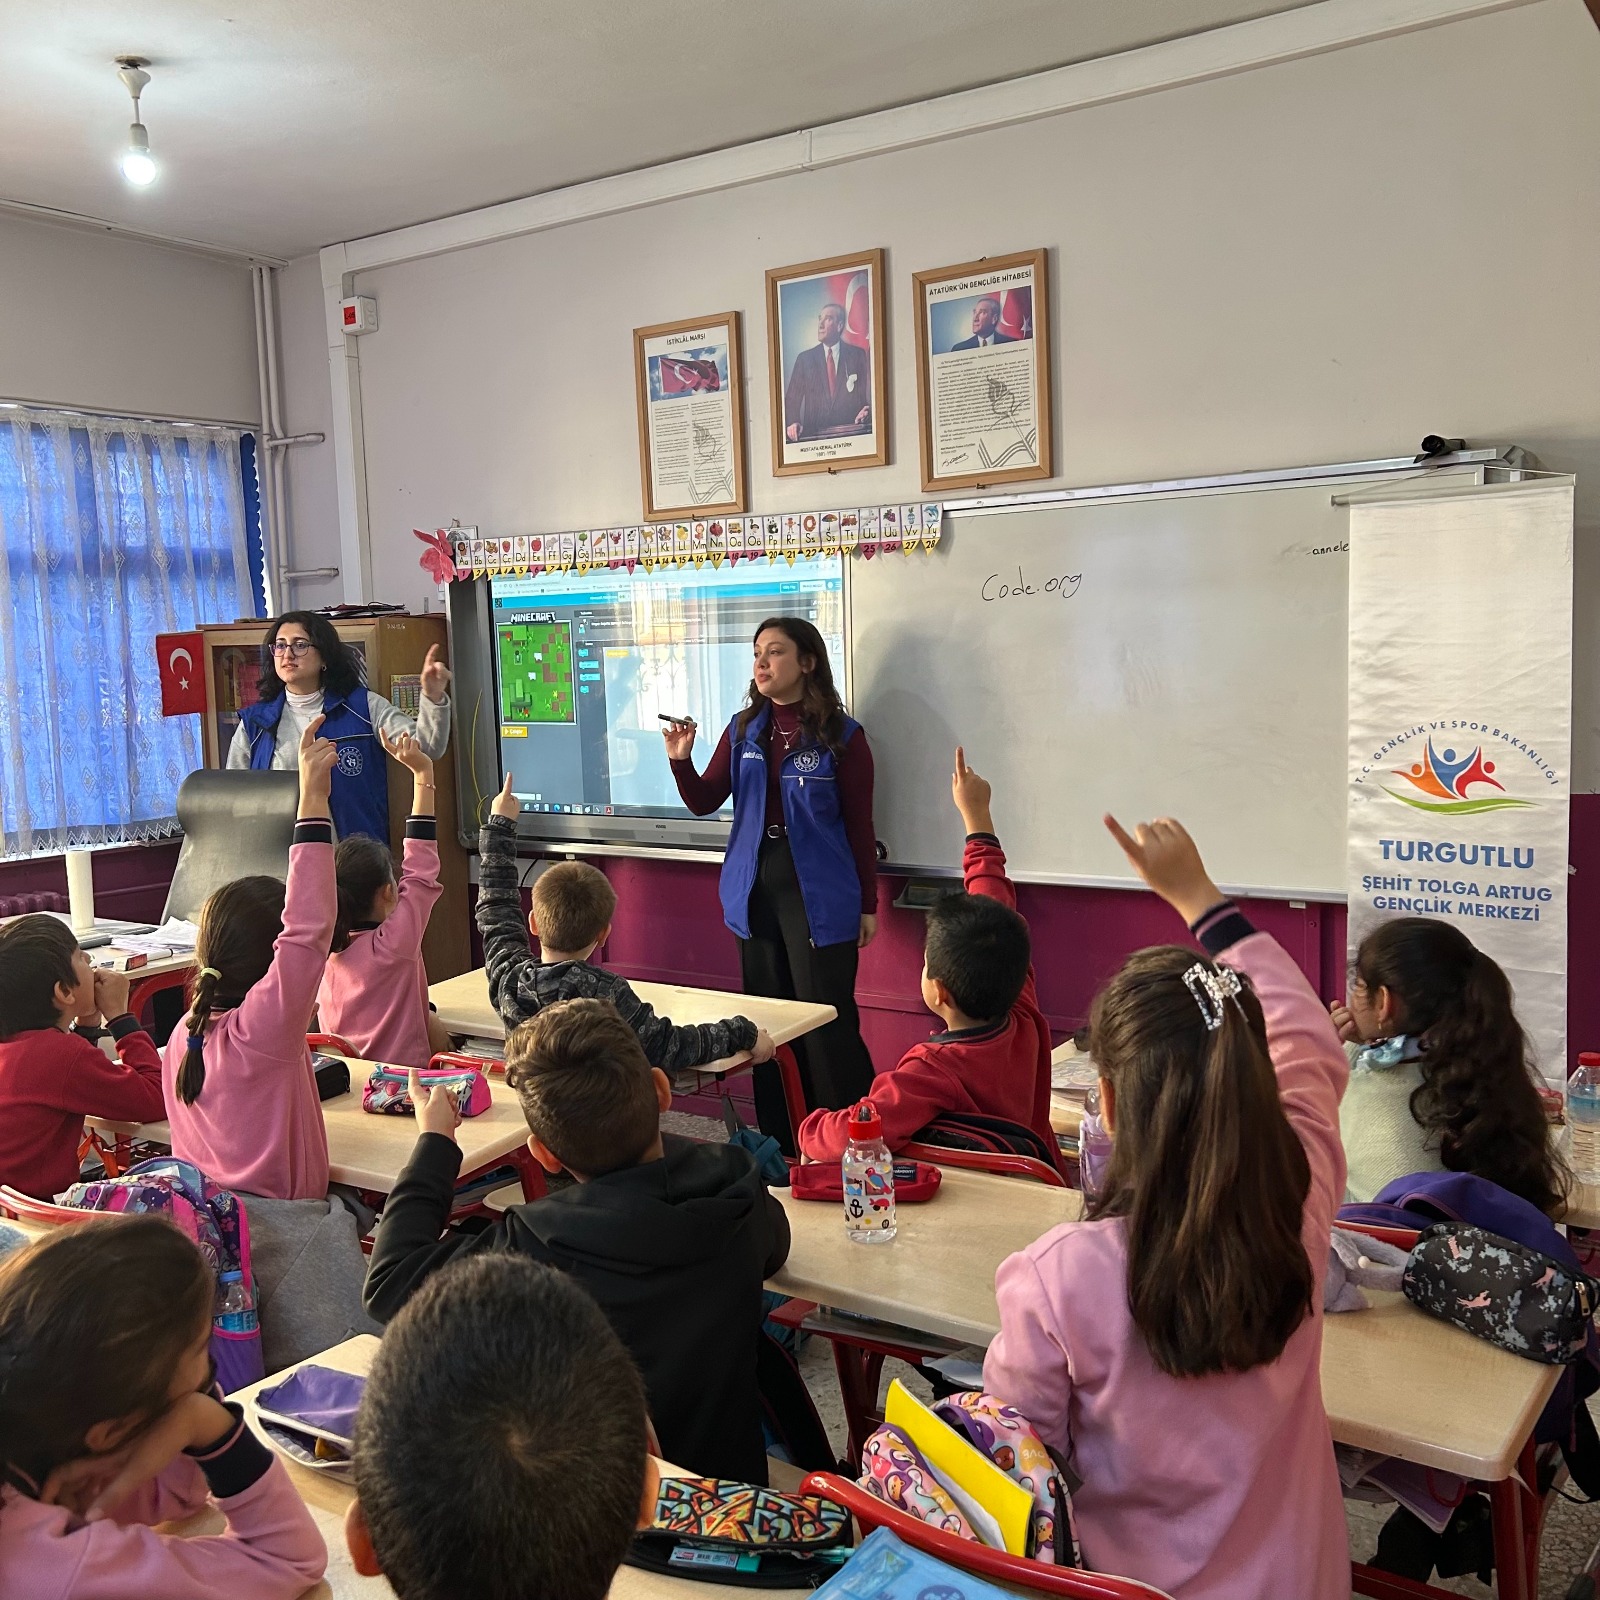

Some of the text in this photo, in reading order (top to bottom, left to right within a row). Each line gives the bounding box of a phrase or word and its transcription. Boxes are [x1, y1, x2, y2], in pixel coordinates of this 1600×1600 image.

[969, 275, 1001, 289] GENÇLİĞE
[1002, 269, 1032, 282] HİTABESİ
[459, 557, 468, 565] Aa
[474, 556, 482, 565] Bb
[516, 552, 526, 562] Dd
[532, 552, 541, 562] Ee
[594, 548, 606, 558] Hh
[644, 544, 652, 558] Jj
[678, 540, 687, 551] Ll
[710, 538, 723, 548] Nn
[730, 536, 742, 547] Oo
[768, 534, 778, 550] Pp
[786, 534, 796, 544] Rr
[844, 530, 854, 540] Tt
[863, 528, 876, 539] Uu
[904, 525, 918, 536] Vv
[926, 523, 937, 538] Yy
[628, 560, 635, 568] 12
[644, 558, 654, 566] 13
[678, 556, 686, 564] 15
[696, 554, 704, 563] 16
[712, 552, 722, 562] 17
[732, 552, 740, 560] 18
[750, 552, 759, 560] 19
[768, 550, 778, 560] 20
[786, 550, 796, 559] 21
[805, 548, 817, 558] 22
[826, 547, 836, 556] 23
[862, 544, 876, 553] 25
[885, 542, 897, 551] 26
[904, 540, 917, 550] 27
[926, 540, 936, 549] 28
[981, 565, 1082, 601] Code.org
[510, 611, 556, 623] MINECRAFT
[1354, 720, 1560, 785] T.C. GENÇLİK VE SPOR BAKANLIĞI
[1379, 839, 1535, 869] TURGUTLU
[1362, 873, 1553, 902] ŞEHİT TOLGA ARTUG
[1373, 895, 1540, 922] GENÇLİK MERKEZİ
